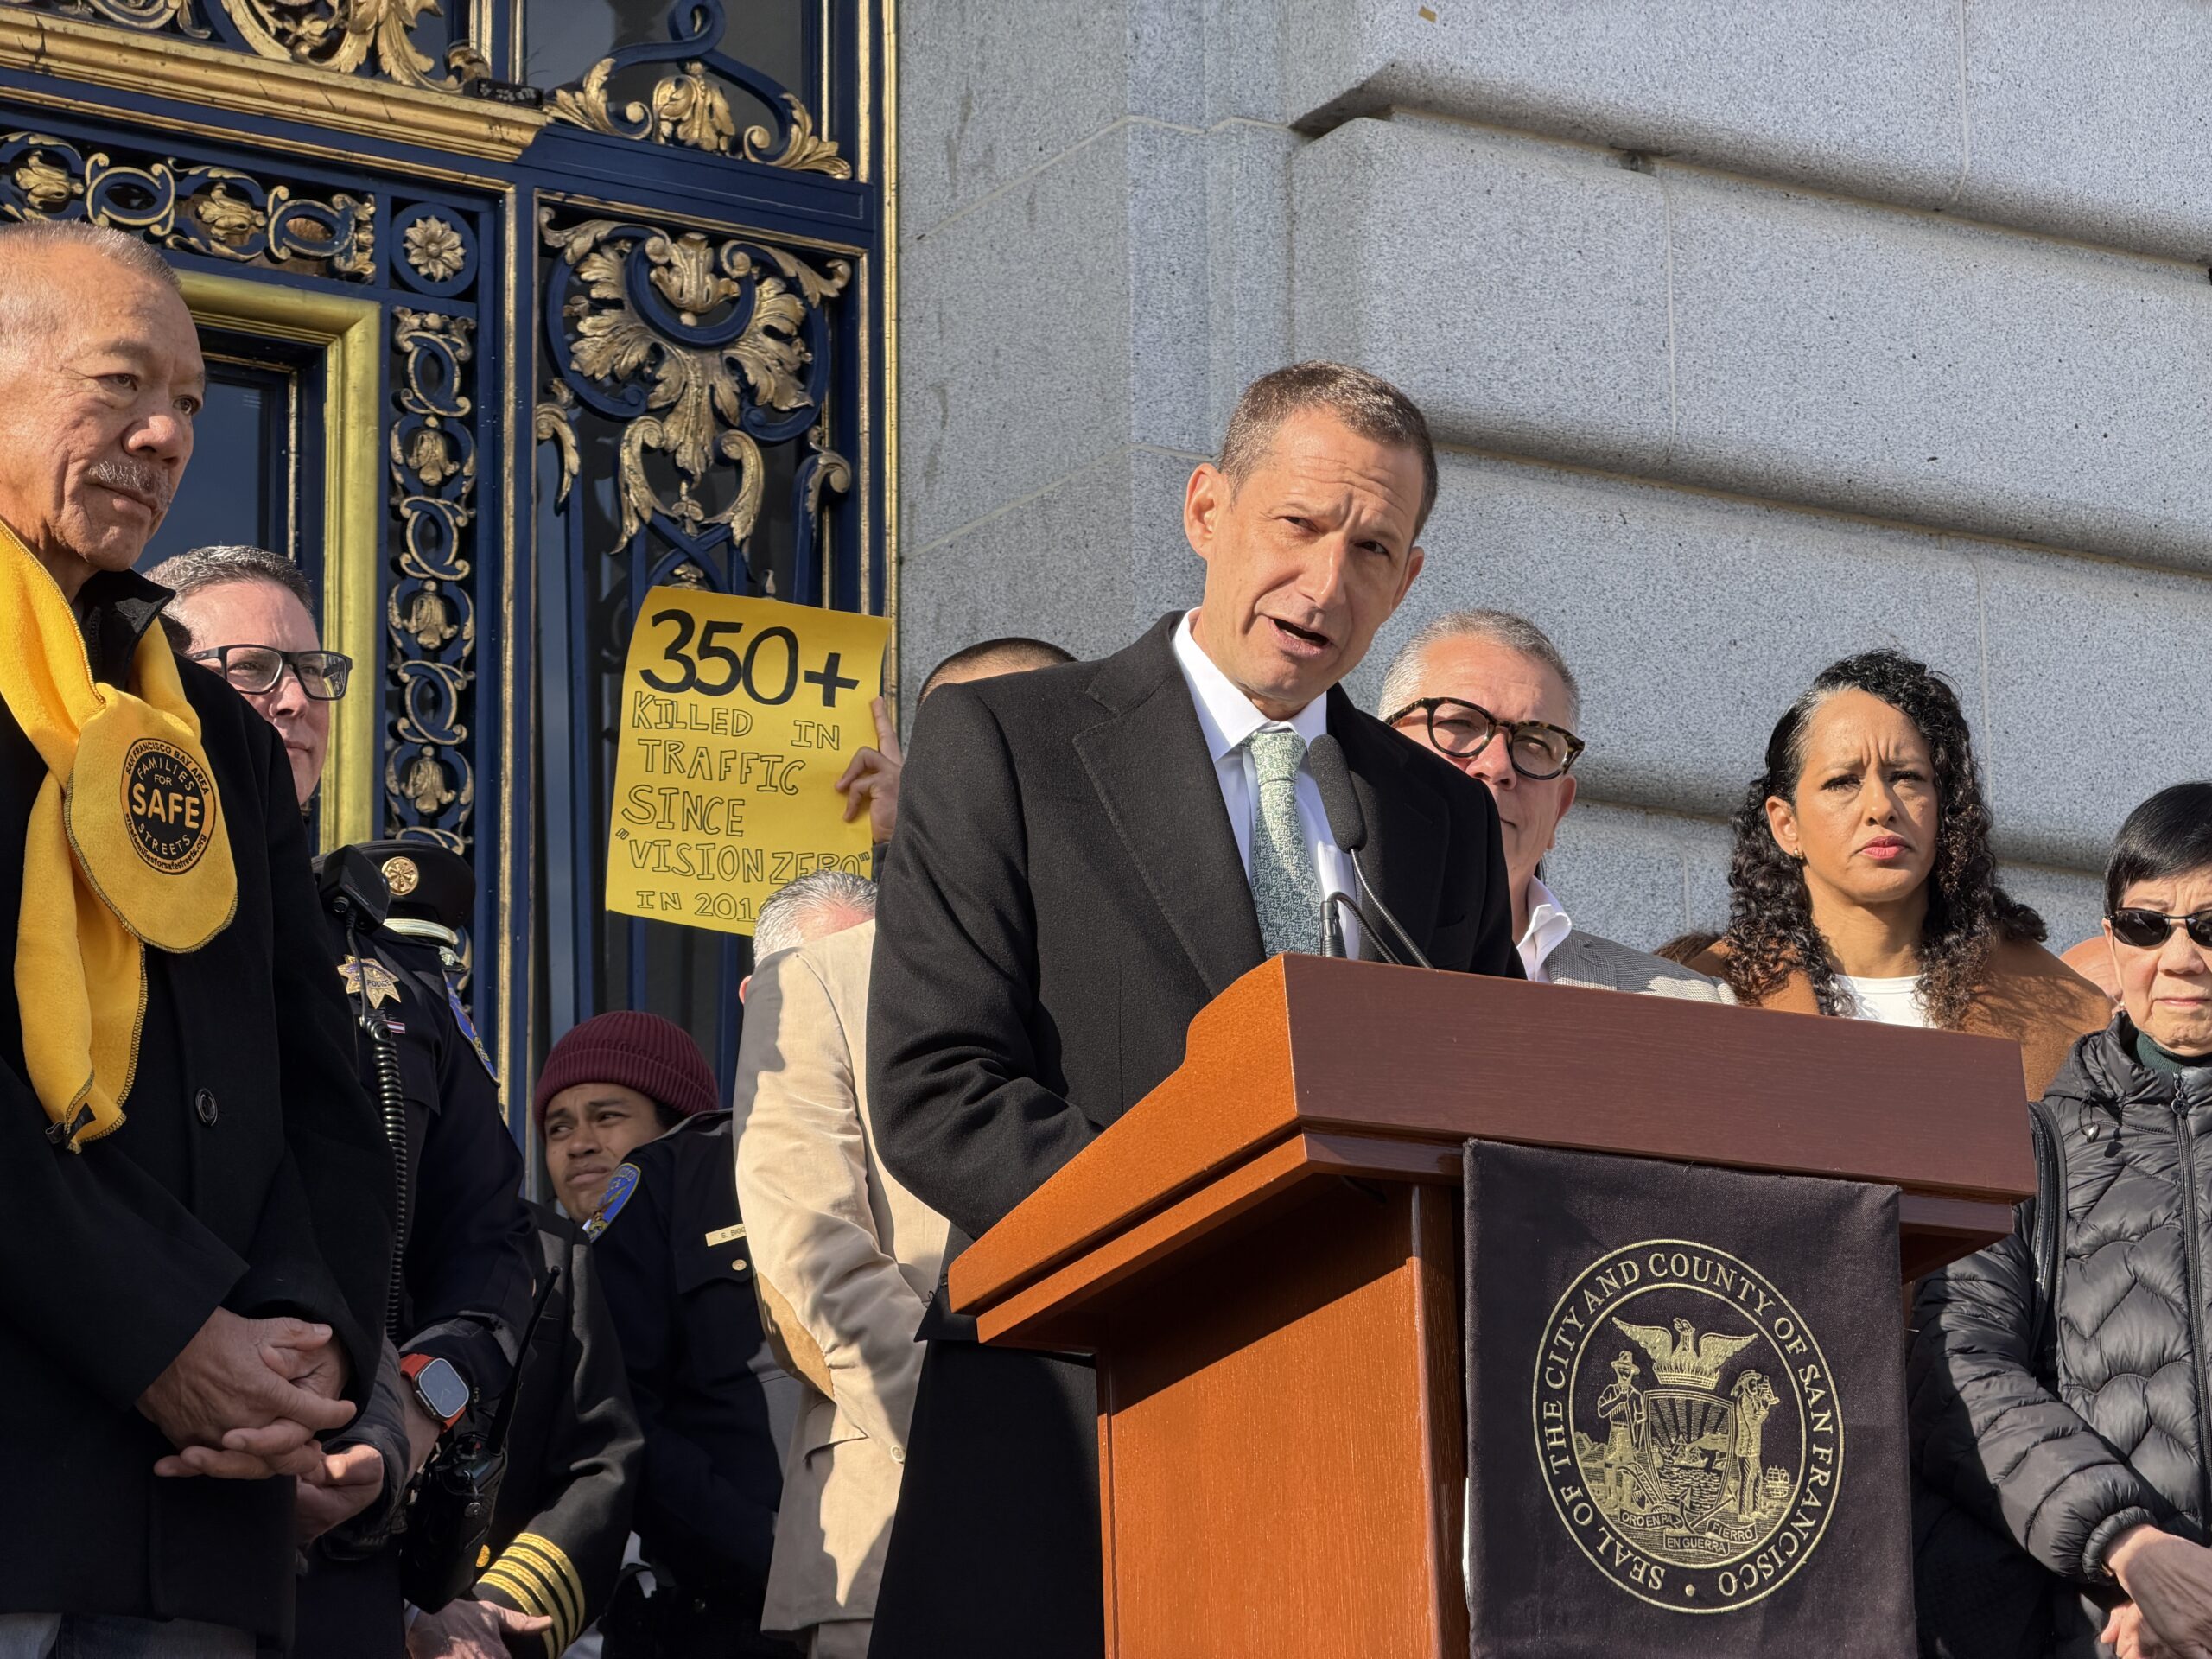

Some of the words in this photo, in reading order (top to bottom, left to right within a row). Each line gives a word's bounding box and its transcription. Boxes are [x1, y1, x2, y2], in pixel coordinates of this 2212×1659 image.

[639, 608, 860, 708] 350+
[632, 690, 753, 737] KILLED
[791, 719, 840, 751] IN
[125, 754, 136, 775] SAN
[132, 741, 172, 758] FRANCISCO
[174, 749, 192, 766] BAY
[191, 767, 210, 795] AREA
[137, 756, 195, 791] FAMILIES
[154, 773, 173, 786] FOR
[637, 738, 806, 795] TRAFFIC
[132, 783, 200, 830] SAFE
[621, 784, 746, 837] SINCE
[138, 823, 190, 855] STREETS
[636, 890, 683, 911] IN
[694, 892, 757, 923] 201
[1583, 1259, 1641, 1314] AND
[1648, 1252, 1774, 1318] COUNTY
[1544, 1311, 1586, 1389] CITY
[1773, 1317, 1808, 1356] OF
[1797, 1363, 1834, 1437] SAN
[1542, 1399, 1571, 1476] THE
[1560, 1484, 1594, 1527] OF
[1621, 1511, 1644, 1527] ORO
[1645, 1515, 1661, 1528] EN
[1661, 1513, 1682, 1529] PAZ
[1711, 1522, 1754, 1541] FIERRO
[1718, 1445, 1834, 1598] FRANCISCO
[1596, 1525, 1666, 1591] SEAL
[1667, 1536, 1681, 1548] EN
[1682, 1537, 1726, 1554] GUERRA
